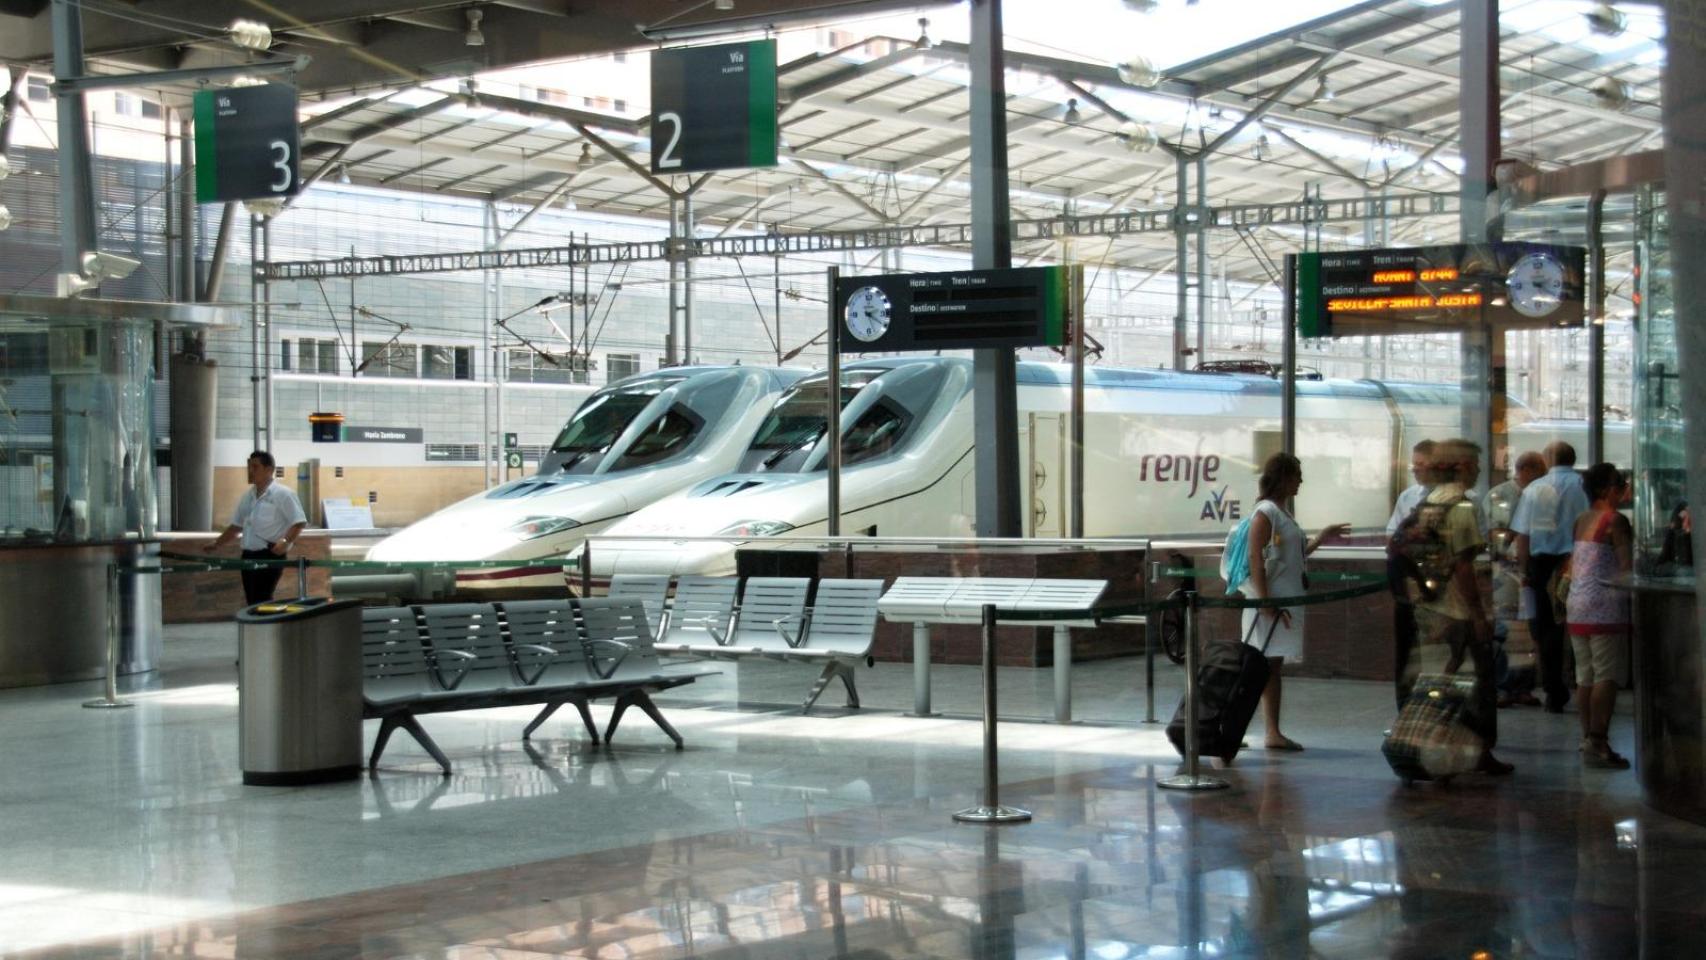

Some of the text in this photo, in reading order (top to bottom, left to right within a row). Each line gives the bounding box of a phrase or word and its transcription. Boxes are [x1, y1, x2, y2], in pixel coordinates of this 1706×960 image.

[658, 112, 682, 168] 2
[271, 140, 292, 192] 3
[1322, 259, 1342, 268] Hora
[1373, 255, 1392, 265] Tren
[910, 279, 927, 288] Hora
[952, 276, 967, 286] Tren
[1322, 286, 1355, 296] Destino
[910, 304, 937, 313] Destino
[1139, 436, 1221, 500] renfe
[1200, 485, 1241, 523] AVE
